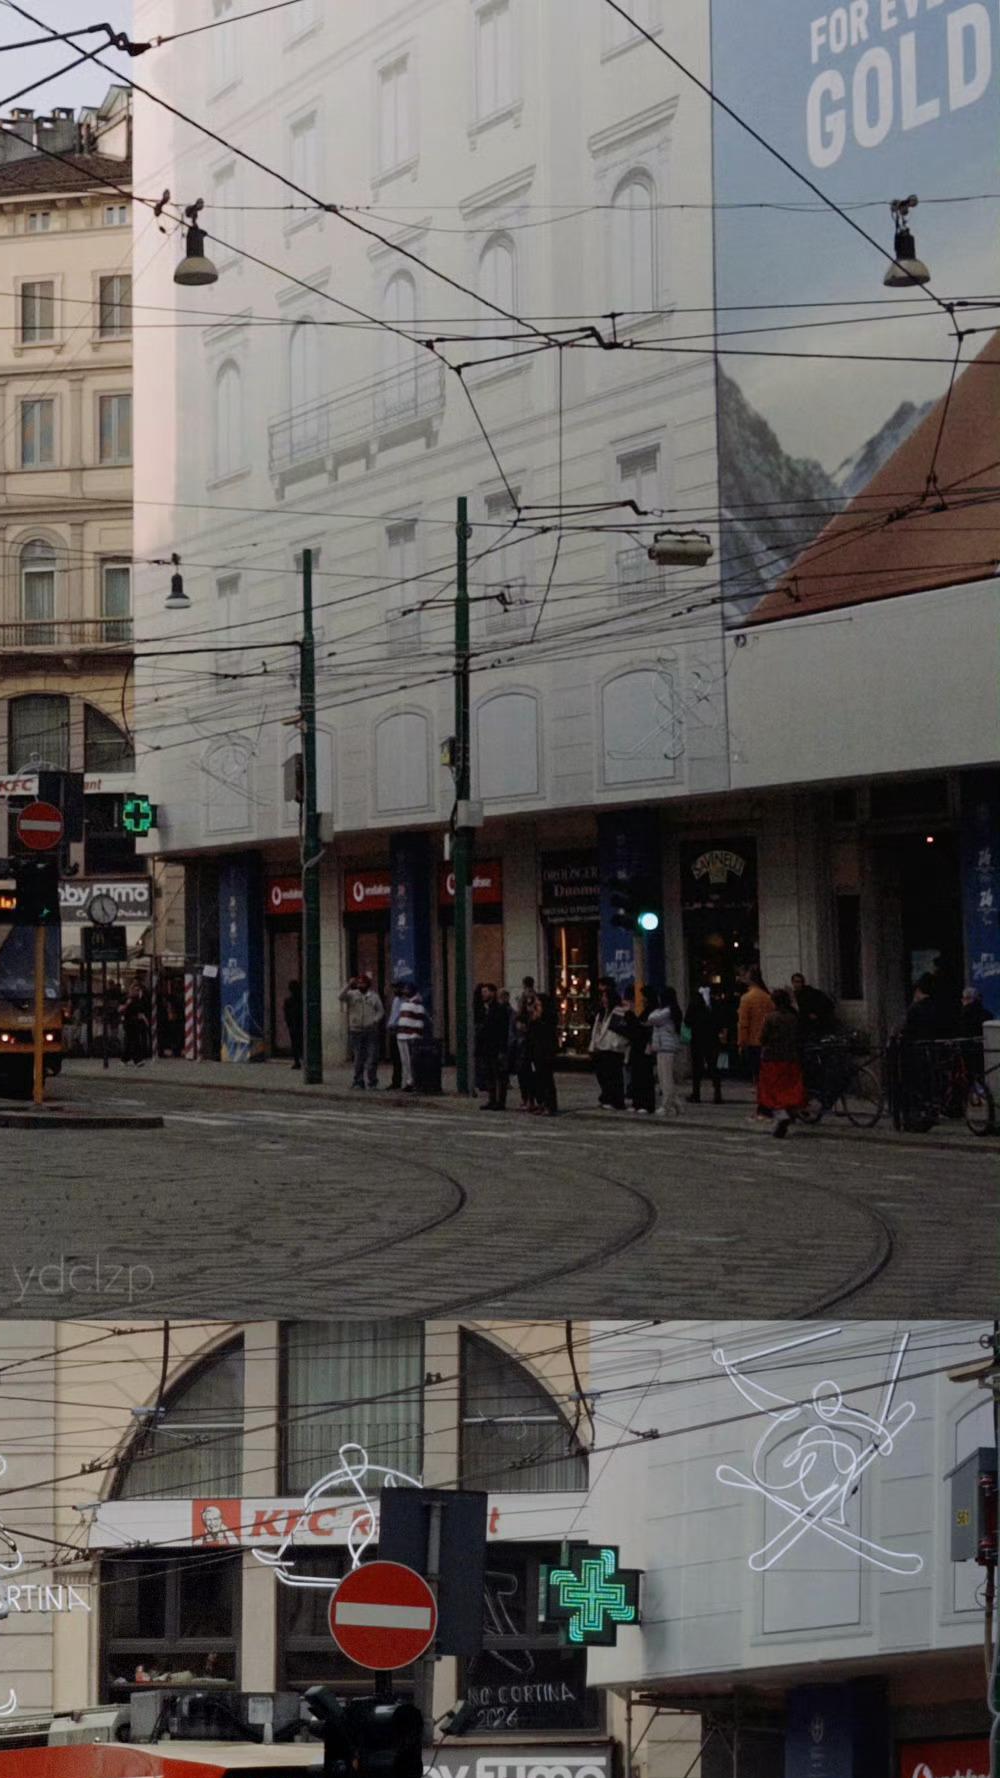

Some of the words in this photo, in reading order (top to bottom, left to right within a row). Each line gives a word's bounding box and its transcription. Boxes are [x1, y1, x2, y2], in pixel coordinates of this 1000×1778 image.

[810, 0, 869, 64] FOR
[807, 3, 992, 169] GOLD
[252, 1509, 337, 1536] KFC
[498, 1682, 577, 1703] CORTINA
